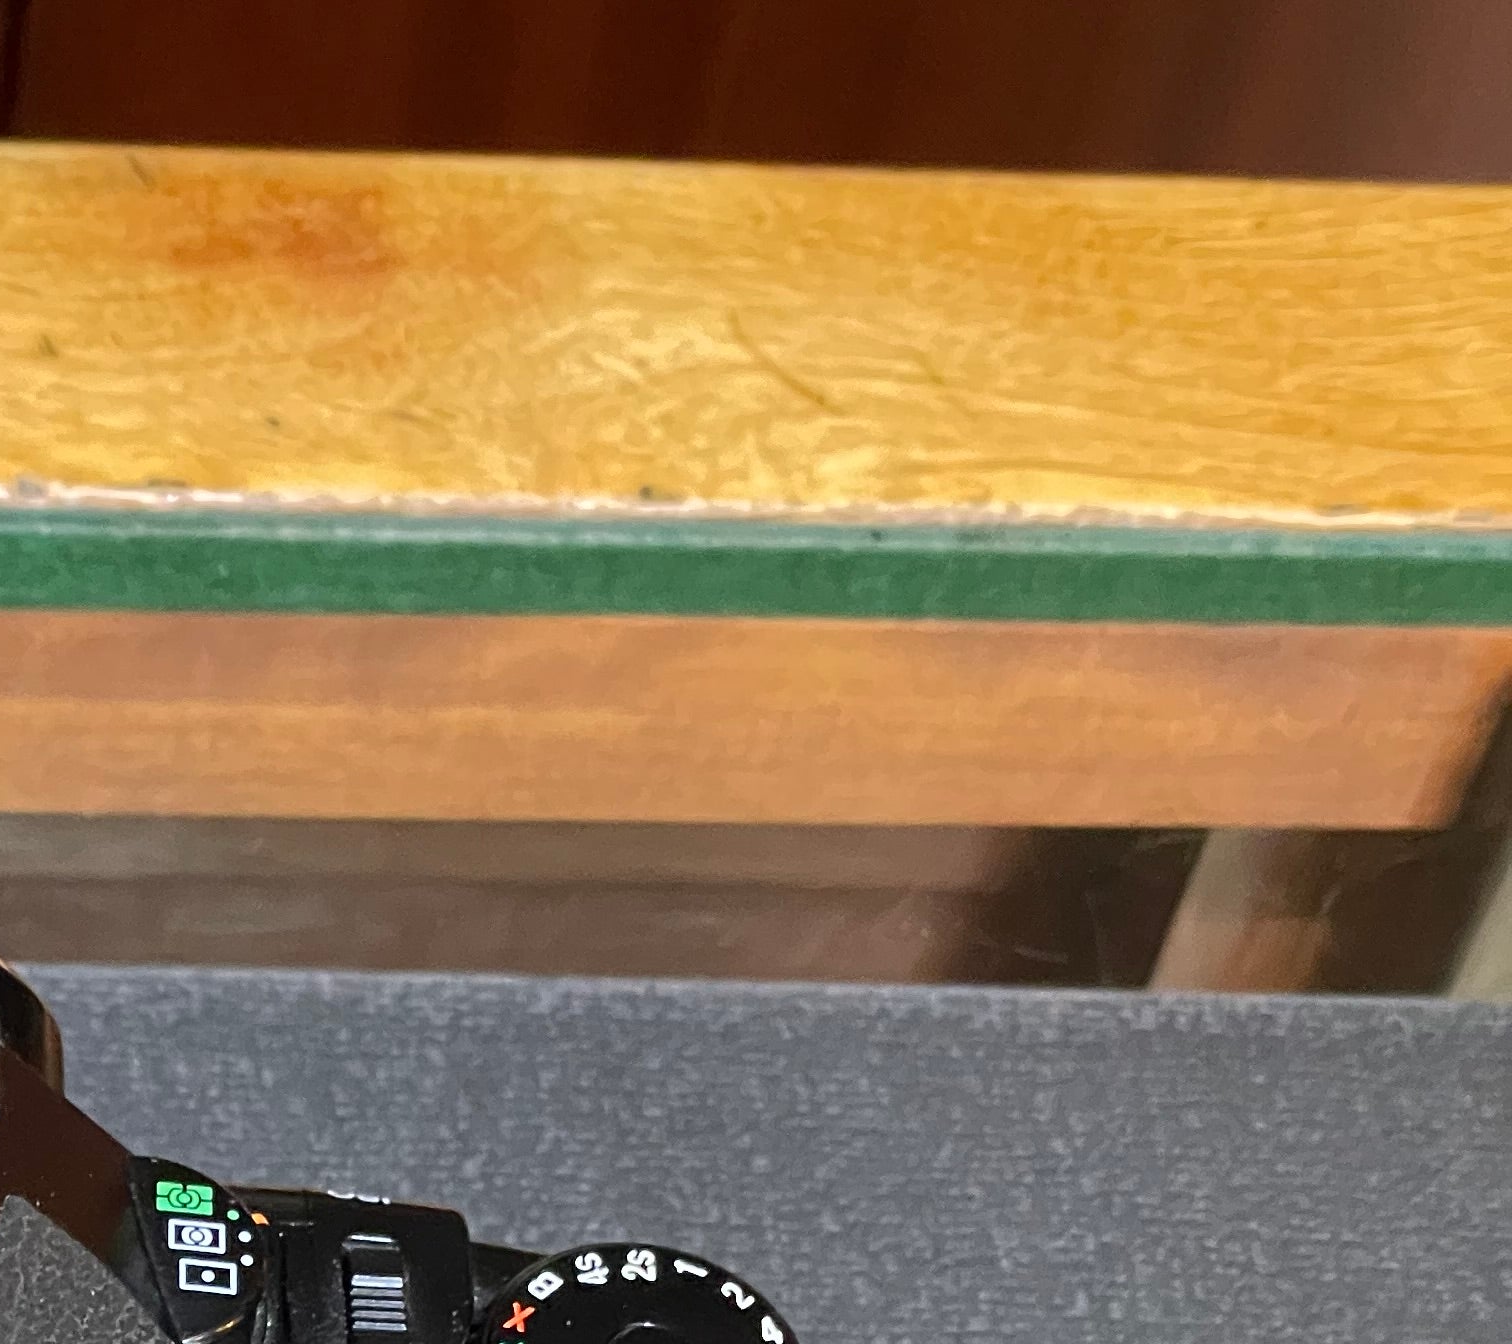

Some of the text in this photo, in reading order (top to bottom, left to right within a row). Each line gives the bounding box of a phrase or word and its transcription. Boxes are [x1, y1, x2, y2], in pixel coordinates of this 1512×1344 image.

[674, 1258, 710, 1278] 1
[527, 1271, 564, 1300] B
[720, 1281, 755, 1310] 2
[502, 1301, 536, 1333] X
